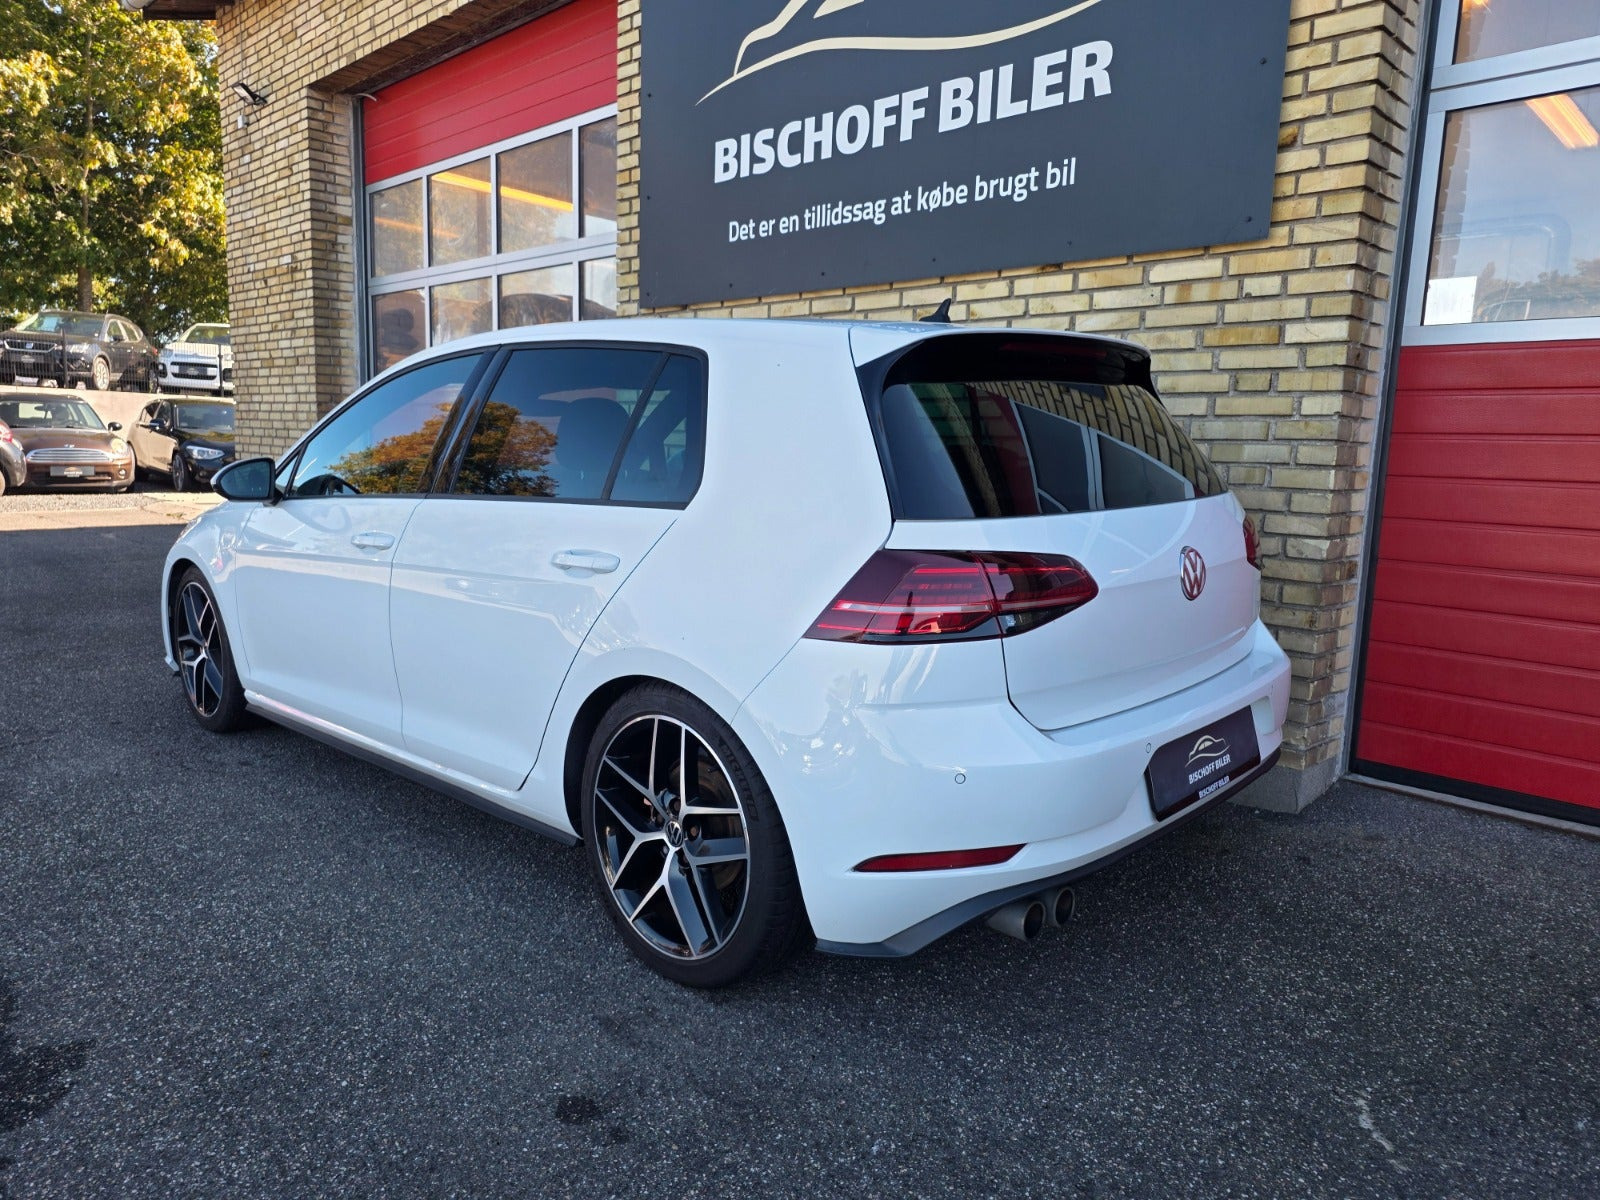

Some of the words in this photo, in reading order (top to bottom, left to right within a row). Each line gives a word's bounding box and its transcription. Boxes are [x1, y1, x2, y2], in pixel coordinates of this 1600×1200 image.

[714, 86, 929, 183] BISCHOFF
[938, 40, 1114, 133] BILER
[729, 219, 756, 242] Det
[759, 217, 776, 238] er
[780, 213, 800, 234] en
[804, 199, 887, 230] tillidssag
[891, 190, 912, 216] at
[917, 181, 968, 213] købe
[974, 165, 1040, 202] brugt
[1045, 156, 1077, 190] bil
[1189, 762, 1215, 784] BISCHOFF
[1215, 754, 1230, 769] BILER
[1199, 782, 1219, 798] BISCHOFF
